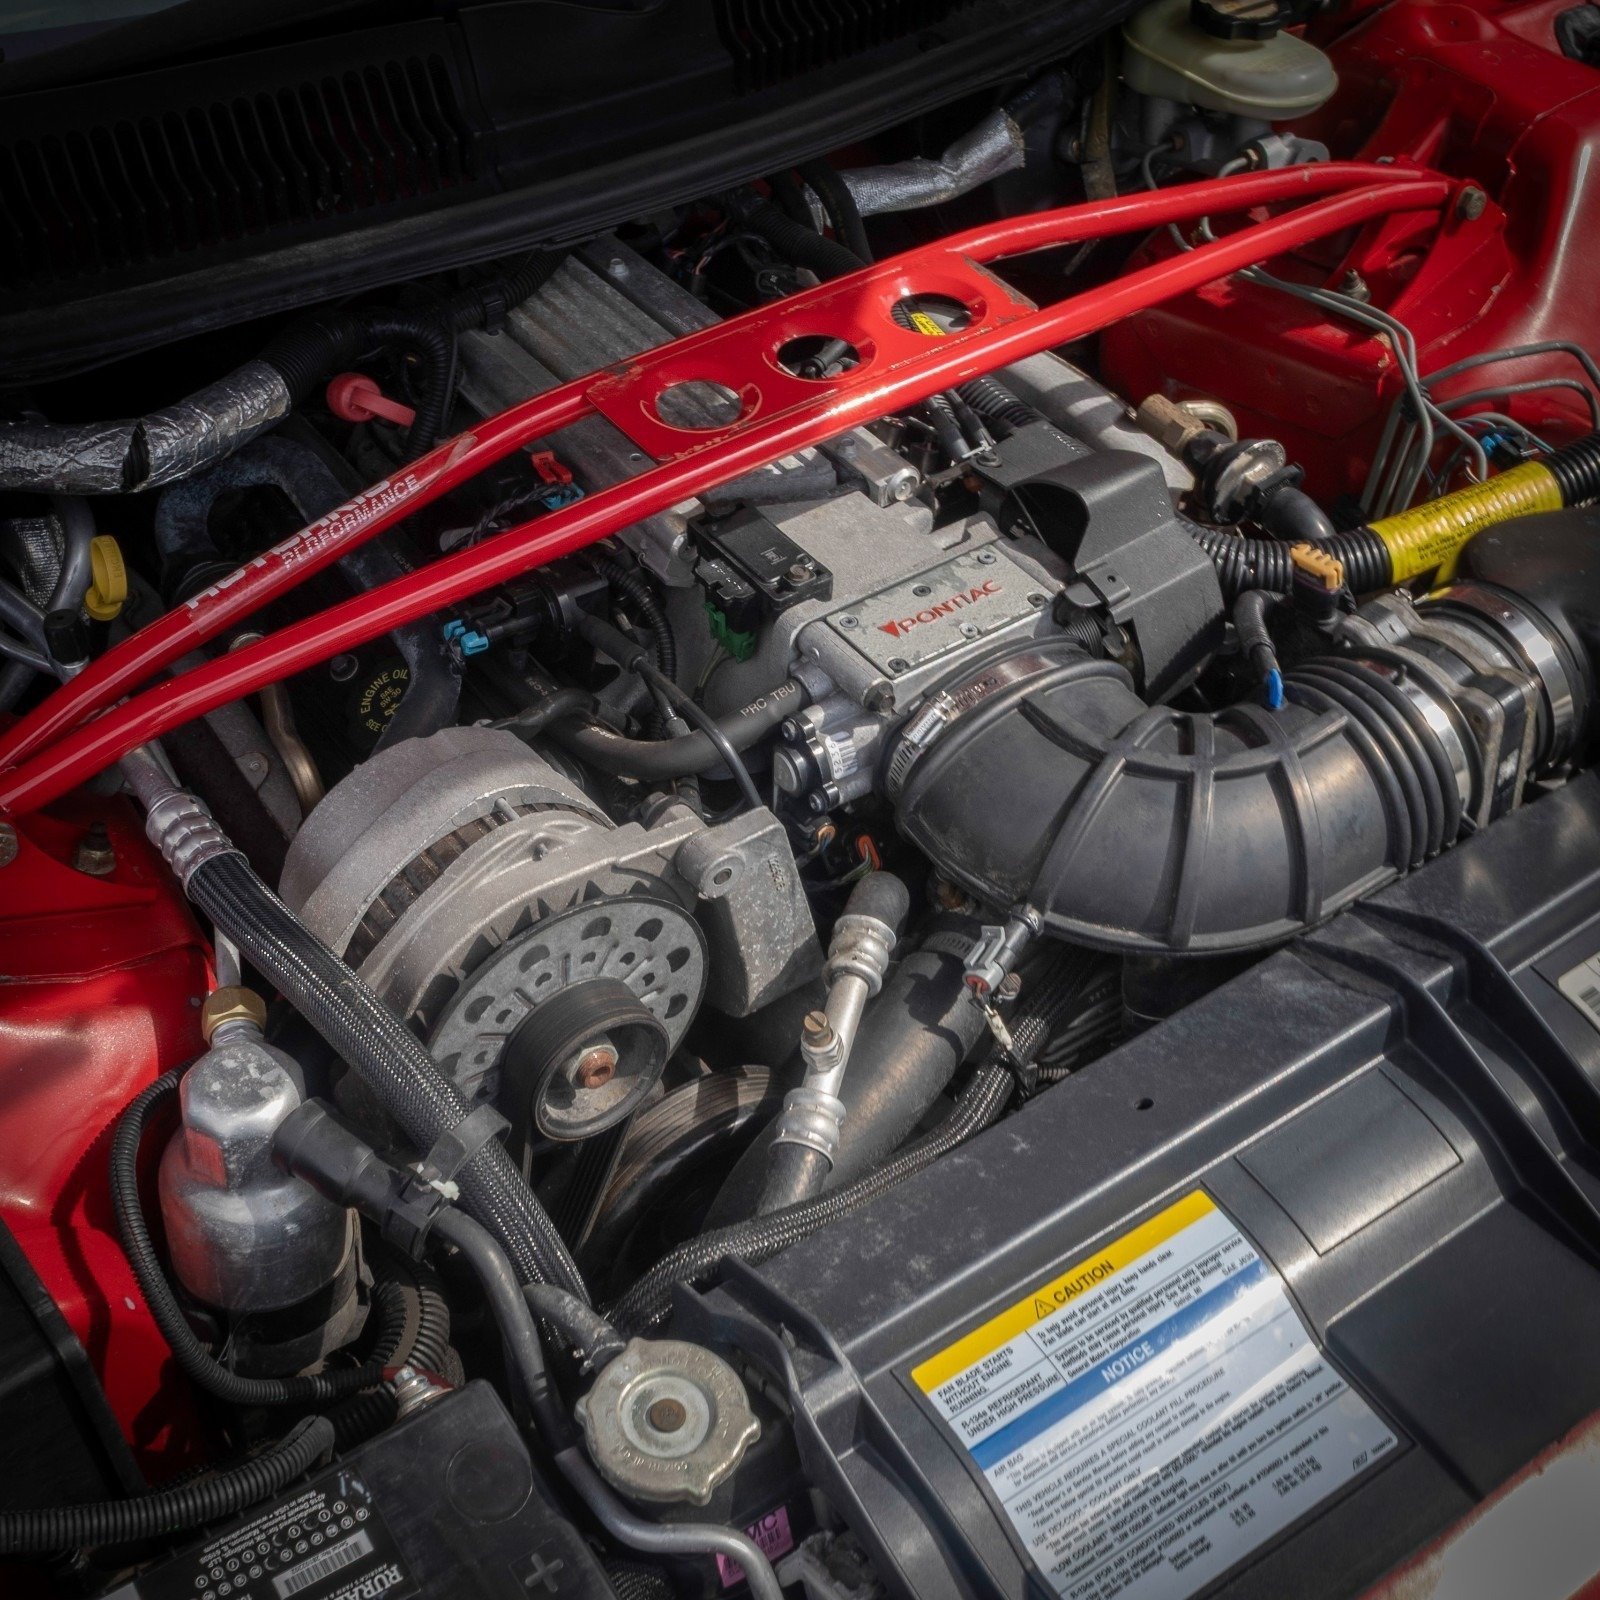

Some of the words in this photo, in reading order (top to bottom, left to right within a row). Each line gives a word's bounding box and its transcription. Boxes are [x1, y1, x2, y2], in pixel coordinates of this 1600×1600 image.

[279, 472, 421, 569] PERFORMANCE
[897, 579, 1001, 633] PONTIAC
[360, 671, 390, 714] ENGINE
[392, 669, 408, 679] OIL
[740, 698, 766, 716] PRC
[769, 682, 795, 700] TBU
[366, 719, 381, 732] SEE
[1036, 1329, 1047, 1340] To
[1044, 1320, 1061, 1334] help
[1059, 1309, 1078, 1325] avoid
[1076, 1292, 1105, 1314] personal
[1121, 1269, 1139, 1285] keep
[1136, 1258, 1157, 1275] hands
[1051, 1259, 1114, 1305] CAUTION
[1053, 1342, 1079, 1362] System
[1076, 1337, 1086, 1347] to
[1084, 1332, 1094, 1342] be
[1093, 1315, 1120, 1336] serviced
[1119, 1309, 1129, 1320] by
[1126, 1293, 1154, 1315] qualified
[1152, 1275, 1183, 1298] personnel
[1194, 1249, 1223, 1271] Improper
[1220, 1236, 1244, 1254] service
[1042, 1334, 1056, 1346] Fan
[1054, 1322, 1074, 1338] blade
[1072, 1314, 1086, 1327] can
[1085, 1305, 1101, 1319] start
[1100, 1300, 1109, 1309] at
[1107, 1292, 1121, 1304] any
[1060, 1348, 1088, 1369] methods
[1086, 1338, 1102, 1352] may
[1101, 1326, 1121, 1343] cause
[1120, 1309, 1148, 1330] personal
[1165, 1289, 1179, 1301] See
[1177, 1274, 1201, 1293] Service
[936, 1383, 954, 1398] FAN
[954, 1365, 982, 1387] BLADE
[981, 1345, 1014, 1370] STARTS
[1066, 1359, 1090, 1378] General
[1088, 1347, 1110, 1363] Motors
[1108, 1326, 1142, 1351] Corporation
[1098, 1340, 1156, 1384] NOTICE
[942, 1377, 981, 1405] WITHOUT
[980, 1358, 1012, 1382] ENGINE
[948, 1383, 989, 1413] RUNNING.
[966, 1414, 996, 1437] UNDER
[995, 1400, 1018, 1418] HIGH
[1017, 1372, 1060, 1404] PRESSURE
[986, 1372, 1043, 1411] REFRIGERANT
[1014, 1497, 1032, 1513] THIS
[1031, 1477, 1063, 1501] VEHICLE
[1062, 1452, 1100, 1480] REQUIRES
[1098, 1447, 1106, 1456] A
[1105, 1427, 1136, 1451] SPECIAL
[1134, 1404, 1170, 1432] COOLANT
[1167, 1395, 1183, 1409] FILL
[1183, 1366, 1226, 1399] PROCEDURE
[992, 1463, 1007, 1477] AIR
[1006, 1452, 1024, 1468] BAG
[273, 1504, 289, 1516] USA
[1032, 1533, 1047, 1547] USE
[1088, 1479, 1123, 1507] COOLANT
[1122, 1466, 1143, 1483] ONLY
[1109, 1502, 1150, 1534] INDICATOR
[1112, 1554, 1127, 1568] AIR
[1124, 1520, 1176, 1559] CONDITIONED
[1175, 1496, 1210, 1524] VEHICLES
[205, 1556, 222, 1568] LLP
